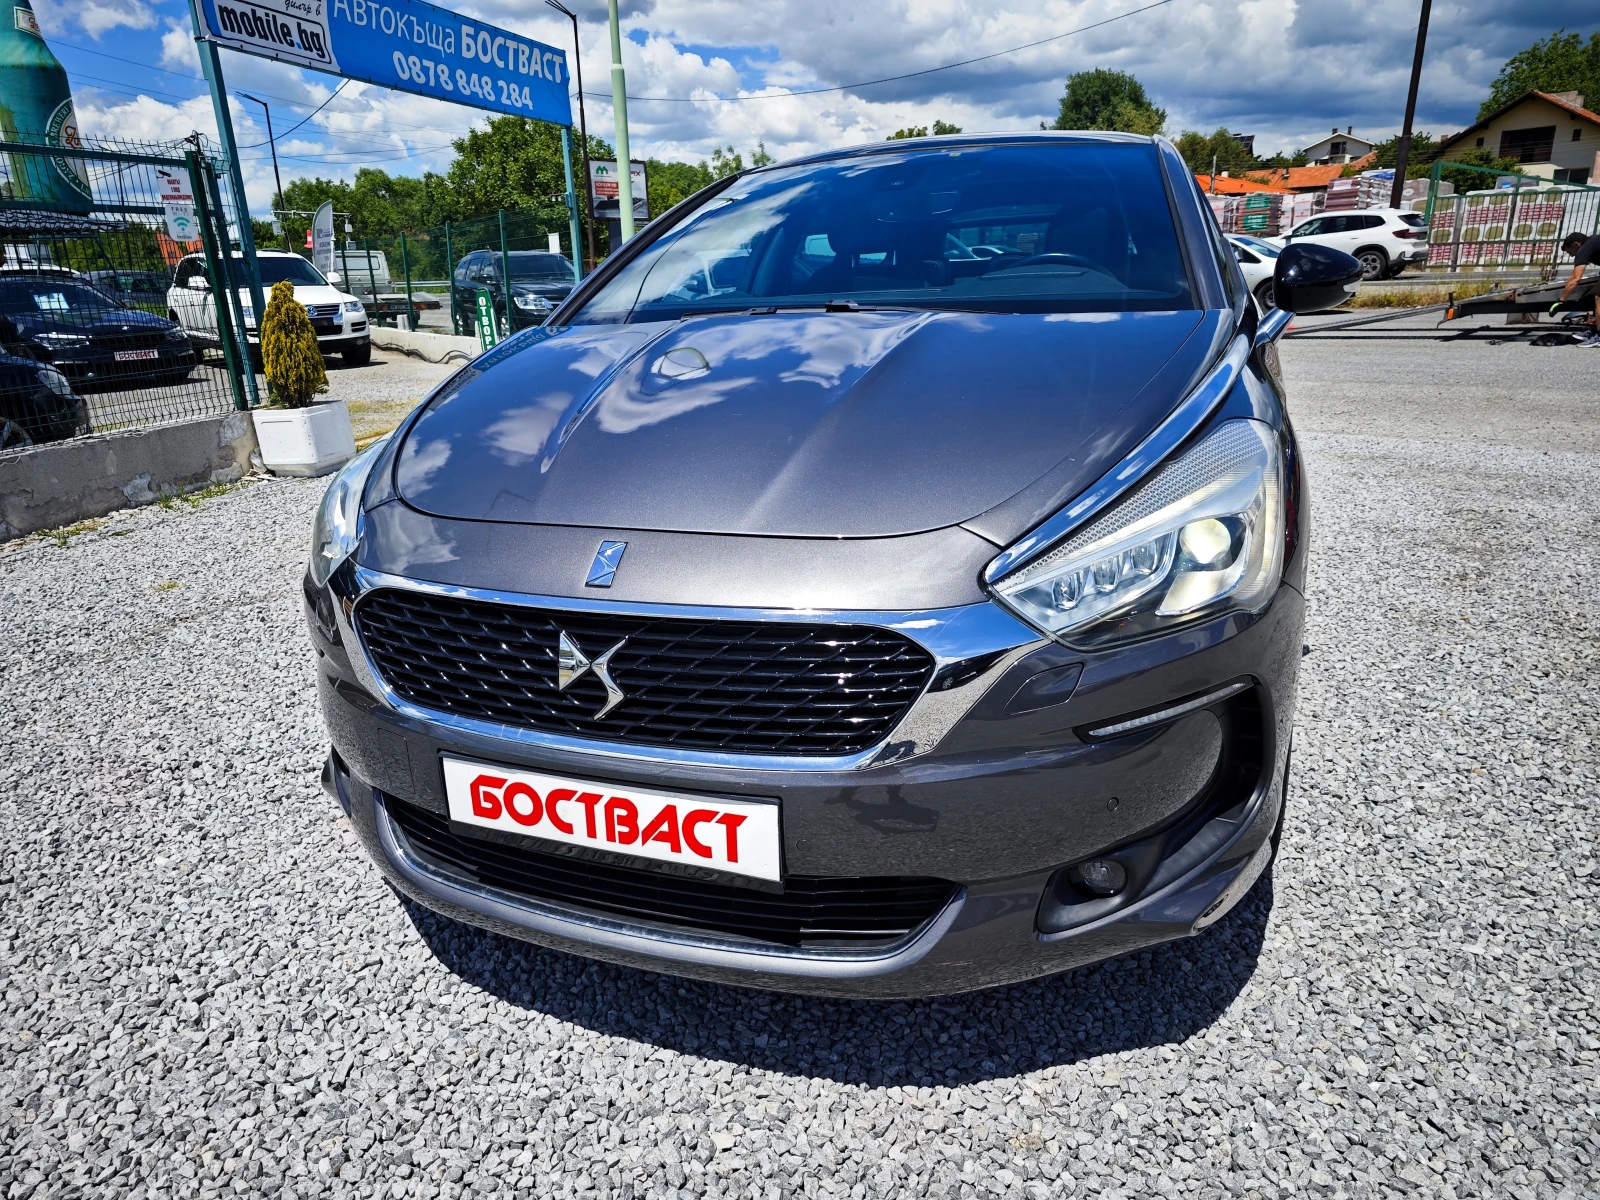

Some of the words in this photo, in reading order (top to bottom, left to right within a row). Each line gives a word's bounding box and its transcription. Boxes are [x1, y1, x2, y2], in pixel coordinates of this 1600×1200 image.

[217, 4, 326, 59] mobile.bg
[460, 24, 564, 84] БОСТВАСТ
[392, 50, 454, 92] 0878
[455, 68, 496, 102] 848
[497, 79, 534, 111] 284
[470, 774, 748, 863] БОСТВАСТ
